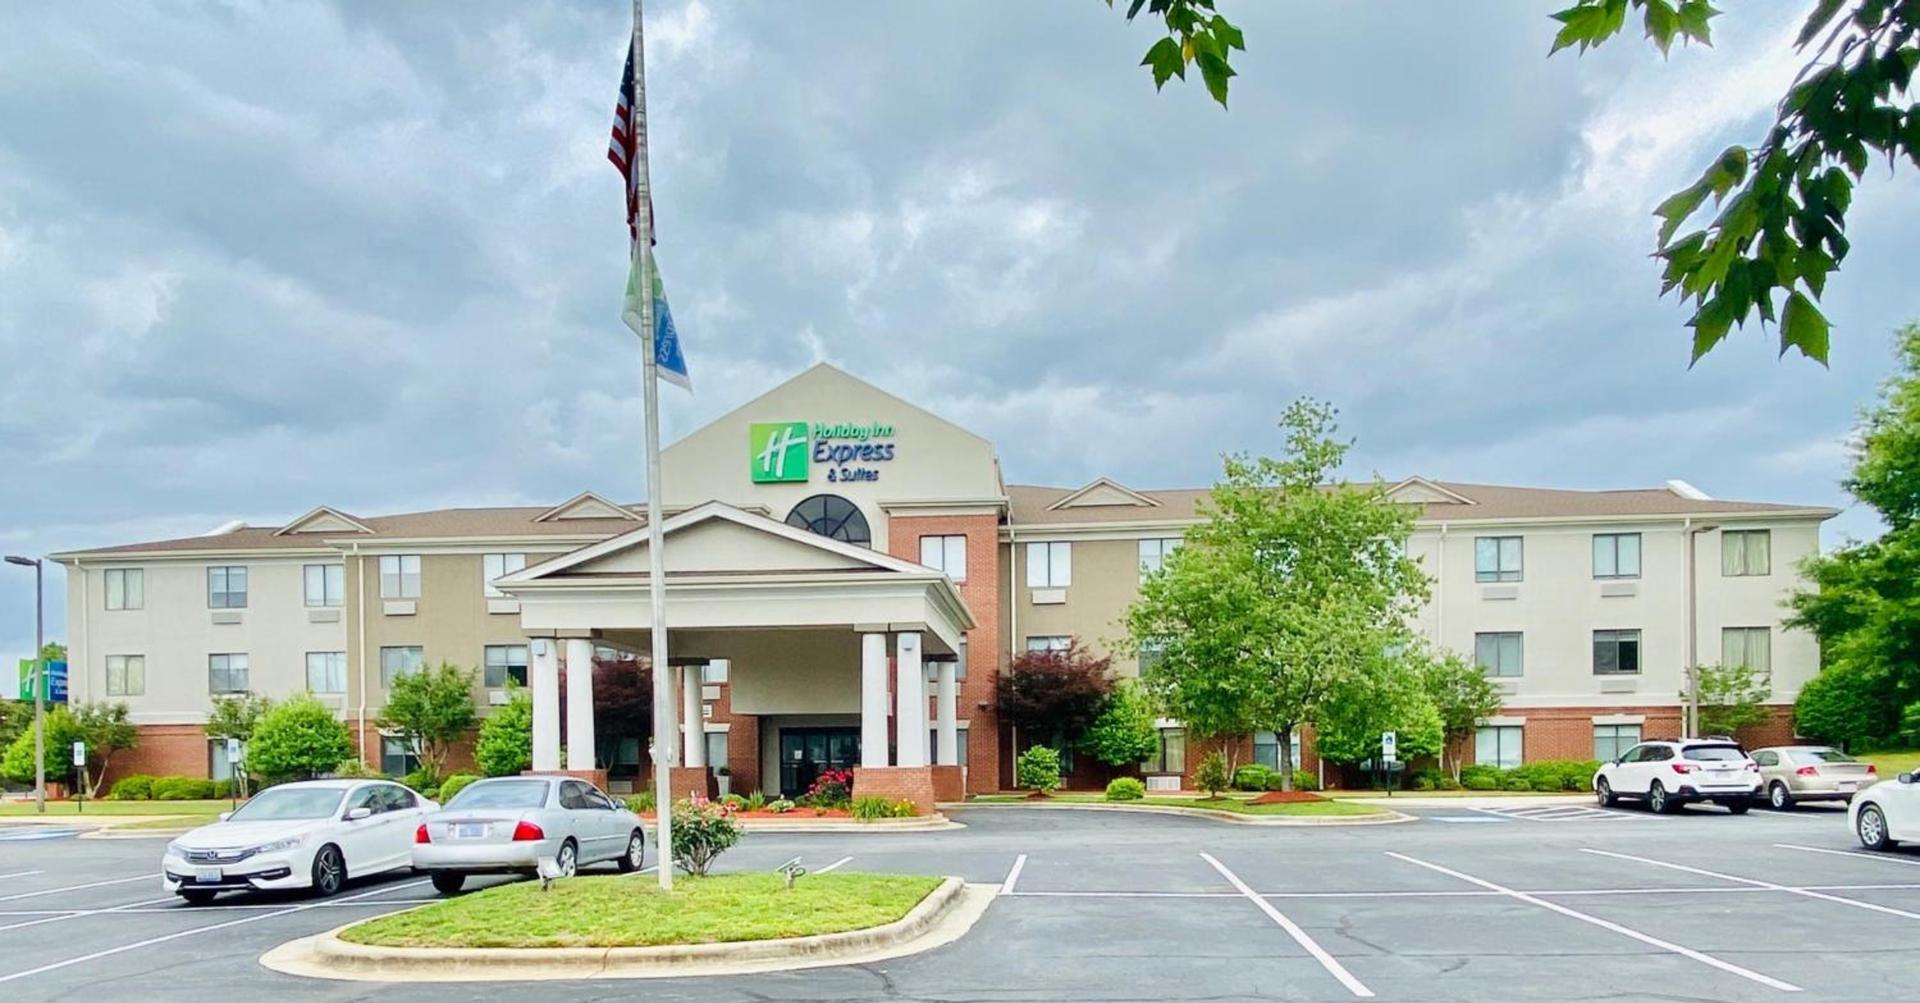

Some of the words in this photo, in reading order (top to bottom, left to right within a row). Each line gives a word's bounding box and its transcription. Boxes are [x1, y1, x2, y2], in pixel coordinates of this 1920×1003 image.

[814, 422, 869, 441] Holiday
[813, 441, 895, 466] Express
[827, 468, 837, 482] &
[839, 468, 880, 482] Suites
